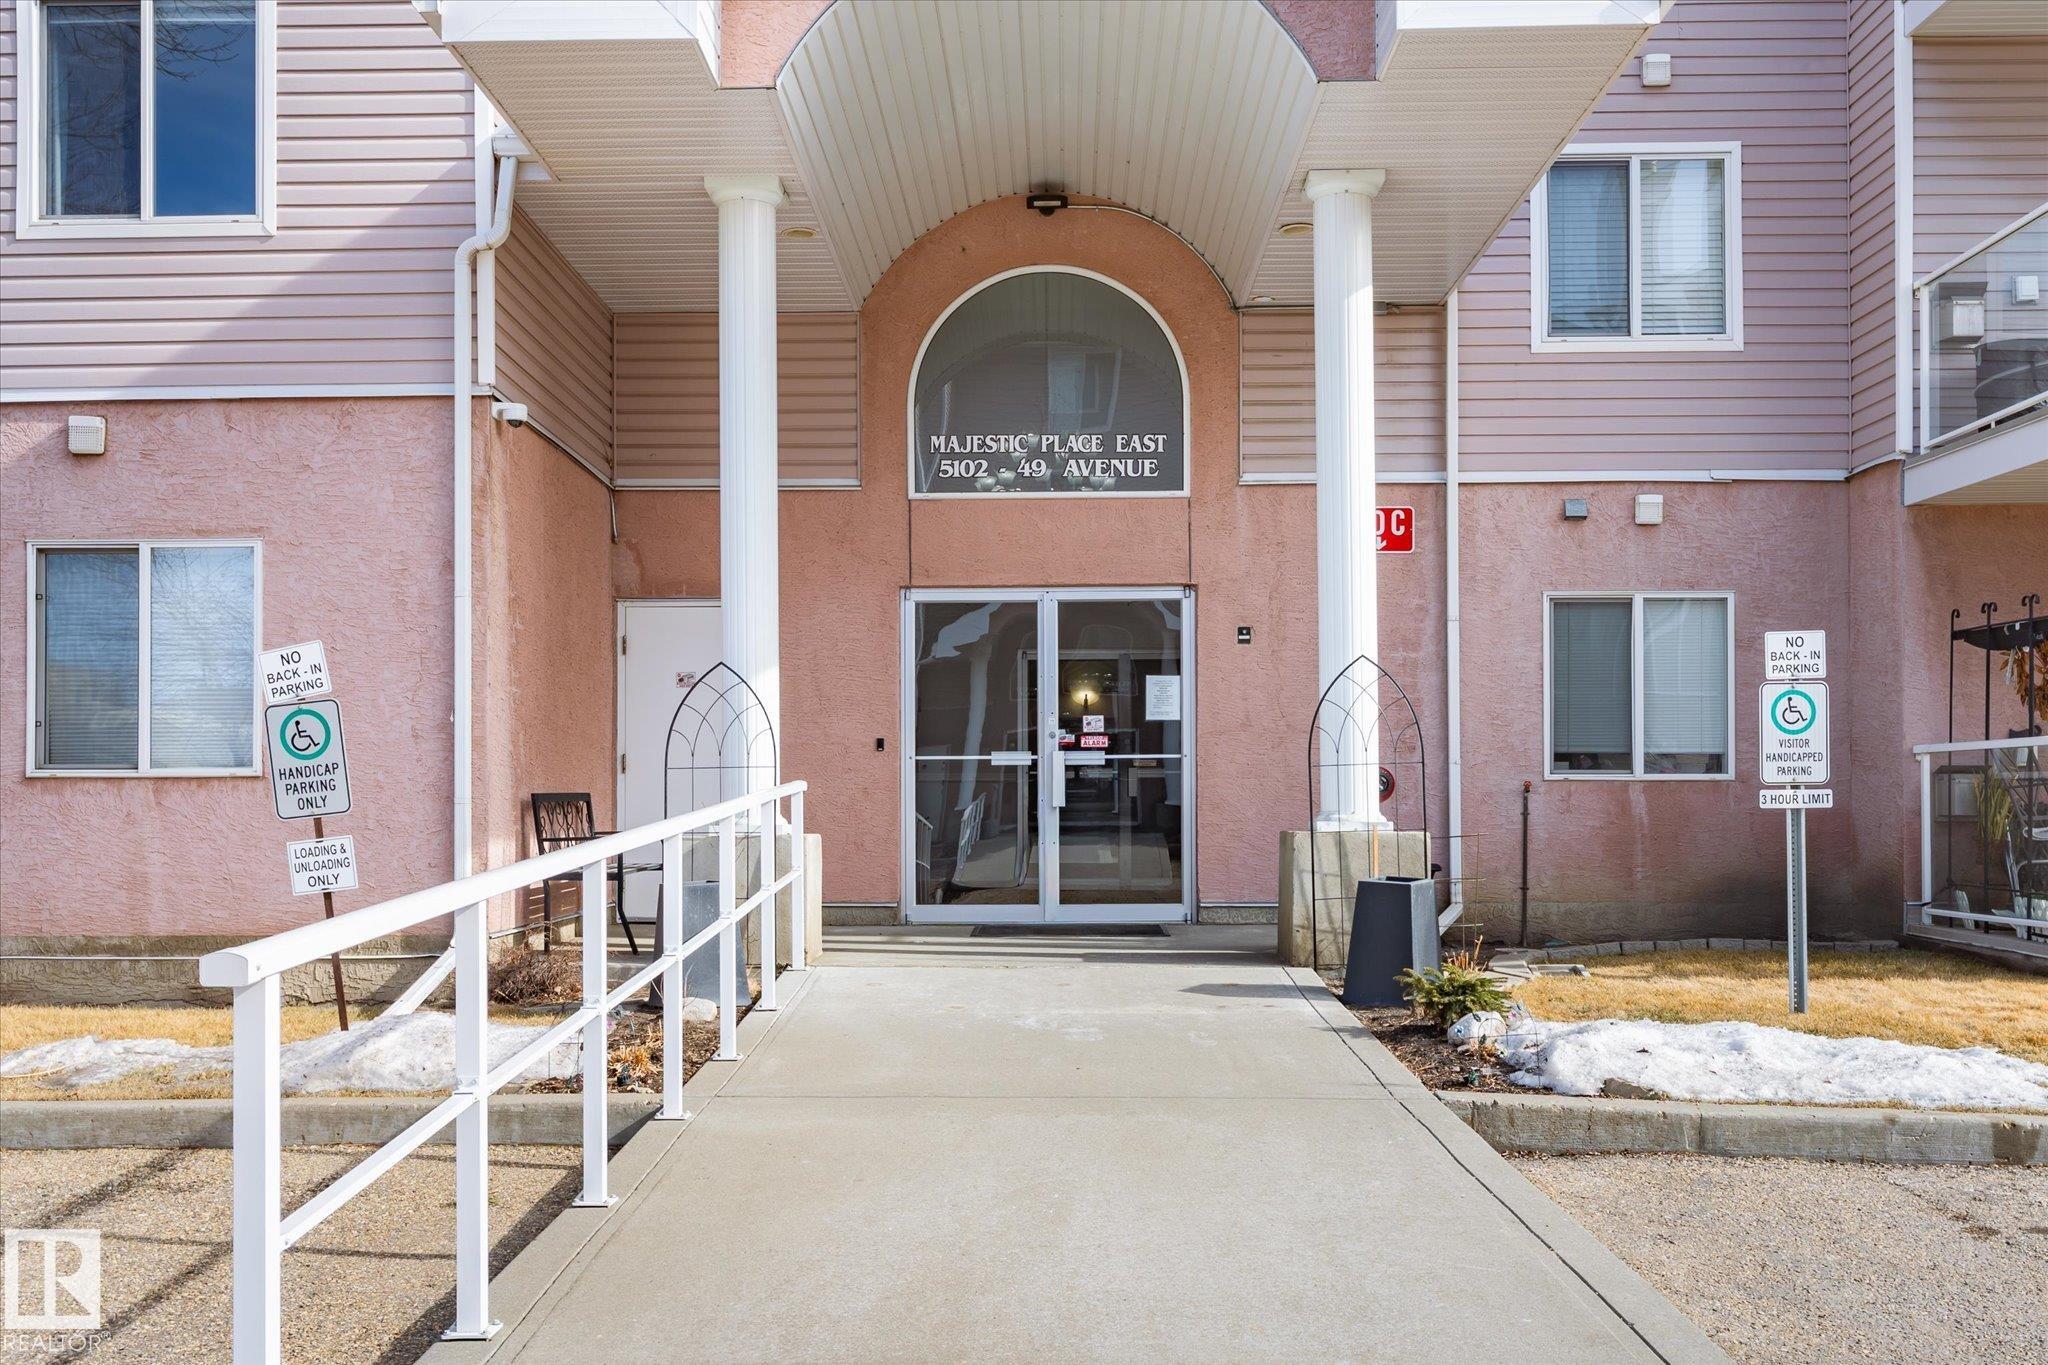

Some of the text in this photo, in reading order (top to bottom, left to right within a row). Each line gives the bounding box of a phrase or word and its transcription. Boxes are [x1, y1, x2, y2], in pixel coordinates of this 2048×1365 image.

[930, 434, 1168, 453] MAJESTIC PLACE EAST
[938, 459, 989, 478] 5102
[1017, 459, 1047, 477] 49
[1062, 459, 1159, 477] AVENUE
[1785, 636, 1805, 648] NO
[280, 650, 302, 667] NO
[1770, 652, 1801, 662] BACK
[1810, 650, 1821, 660] IN
[266, 668, 302, 685] BACK
[310, 663, 323, 677] IN
[1772, 663, 1820, 674] PARKING
[271, 678, 324, 699] PARKING
[1778, 738, 1810, 749] VISITOR
[1765, 752, 1824, 763] HANDICAPPED
[279, 762, 340, 781] HANDICAP
[1777, 765, 1812, 777] PARKING
[285, 778, 337, 796] PARKING
[297, 795, 328, 811] ONLY
[1761, 793, 1831, 805] 3 HOUR LIMIT
[294, 843, 347, 860] LOADING &
[294, 857, 351, 874] UNLOADING
[307, 873, 340, 888] ONLY
